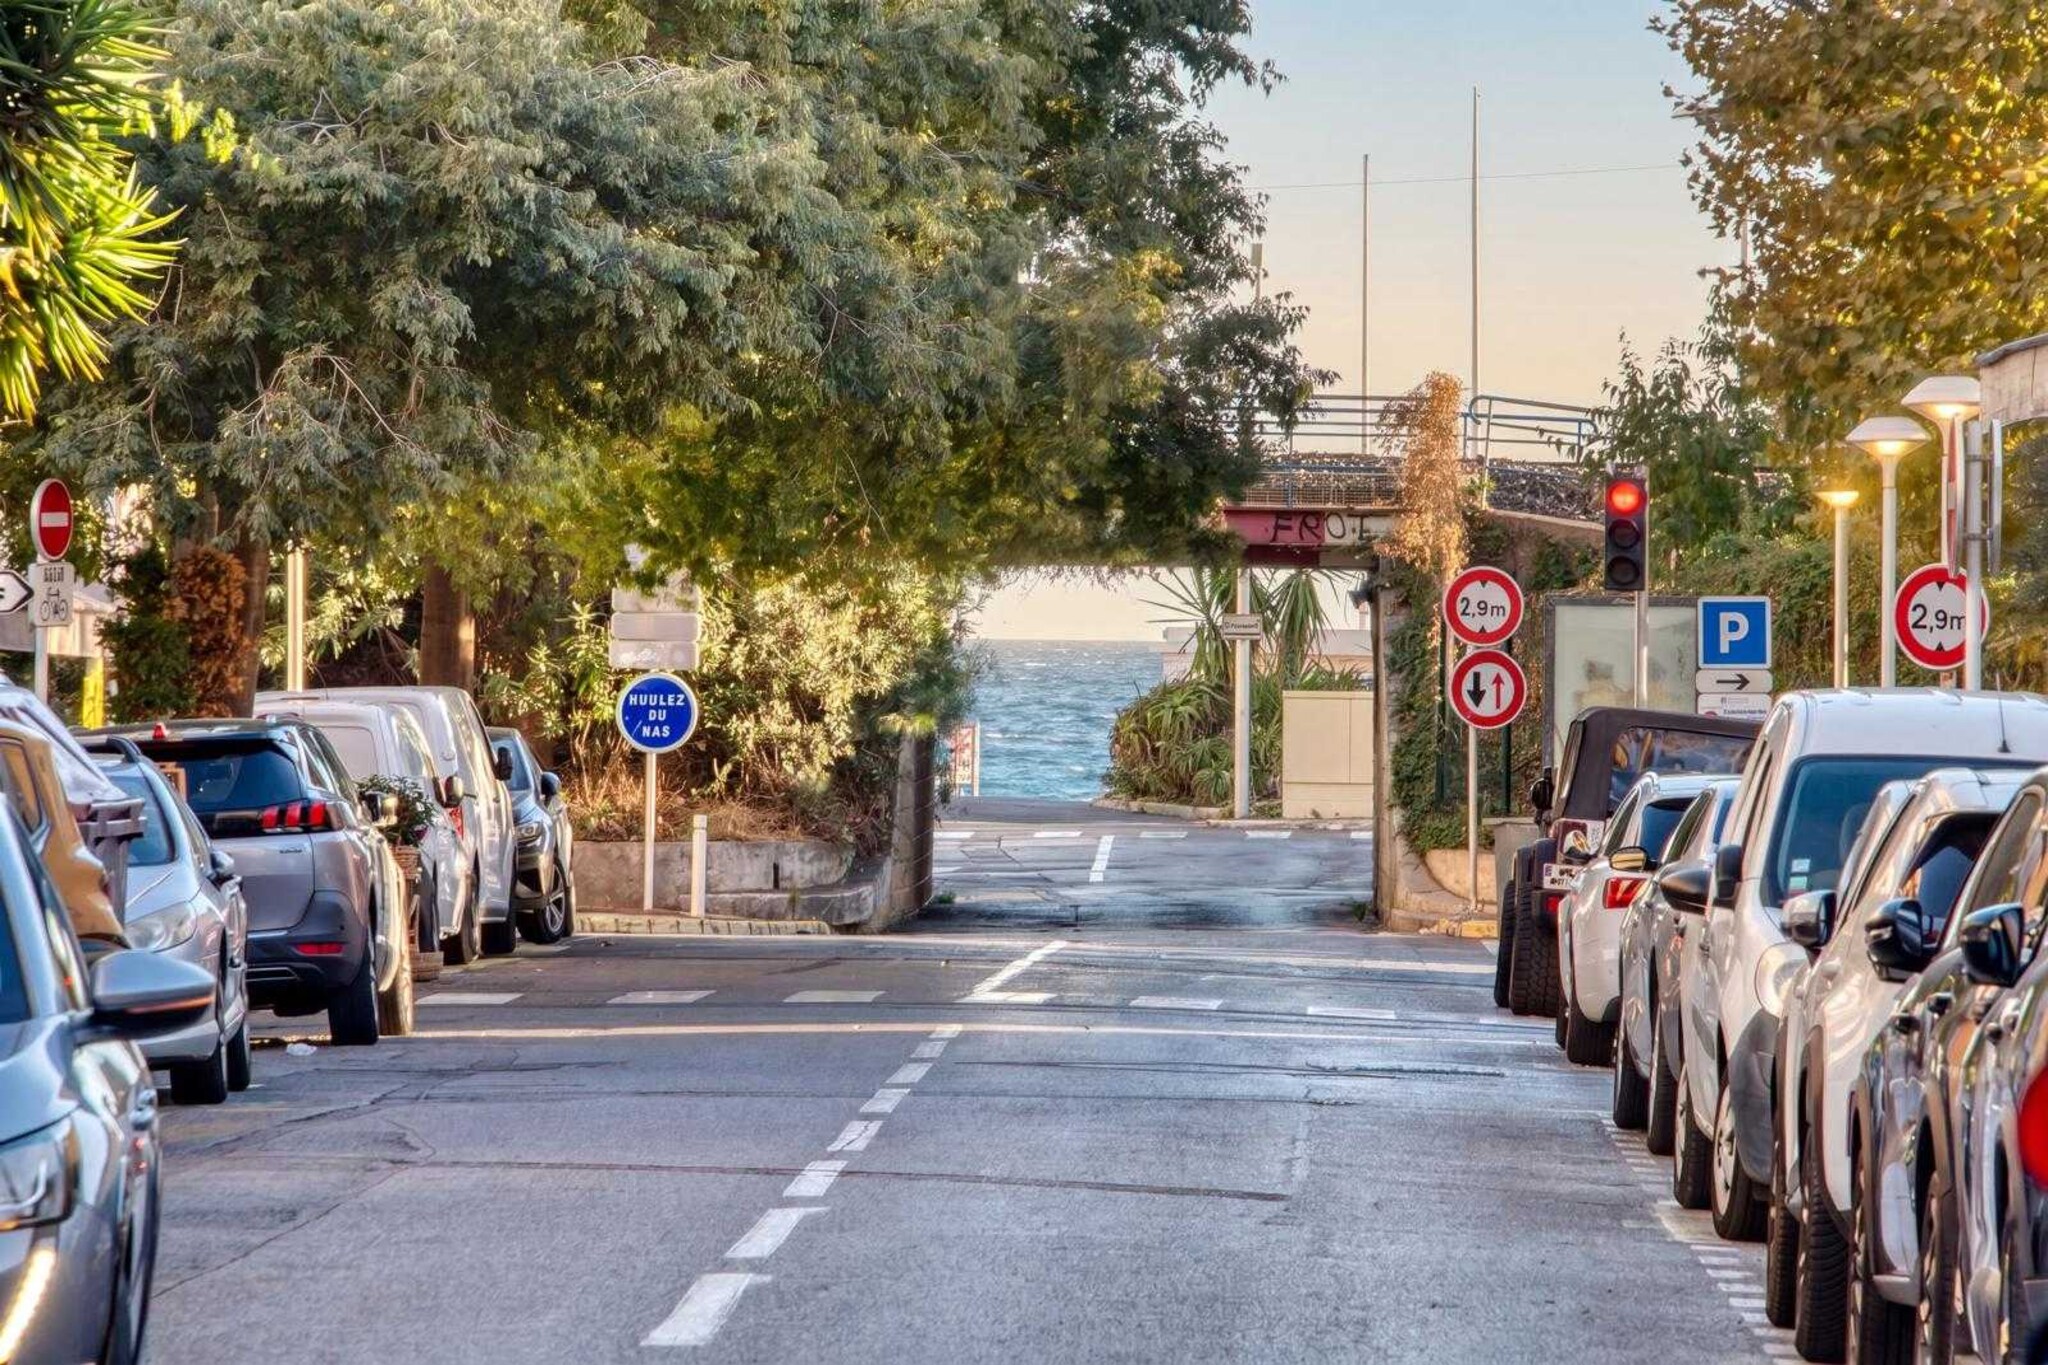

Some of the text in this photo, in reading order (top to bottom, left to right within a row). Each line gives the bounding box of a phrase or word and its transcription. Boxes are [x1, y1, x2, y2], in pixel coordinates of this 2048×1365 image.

[1460, 597, 1506, 619] 2,9m
[1719, 611, 1749, 654] P
[629, 694, 685, 706] HUULEZ
[648, 709, 667, 721] DU
[642, 725, 671, 738] NAS
